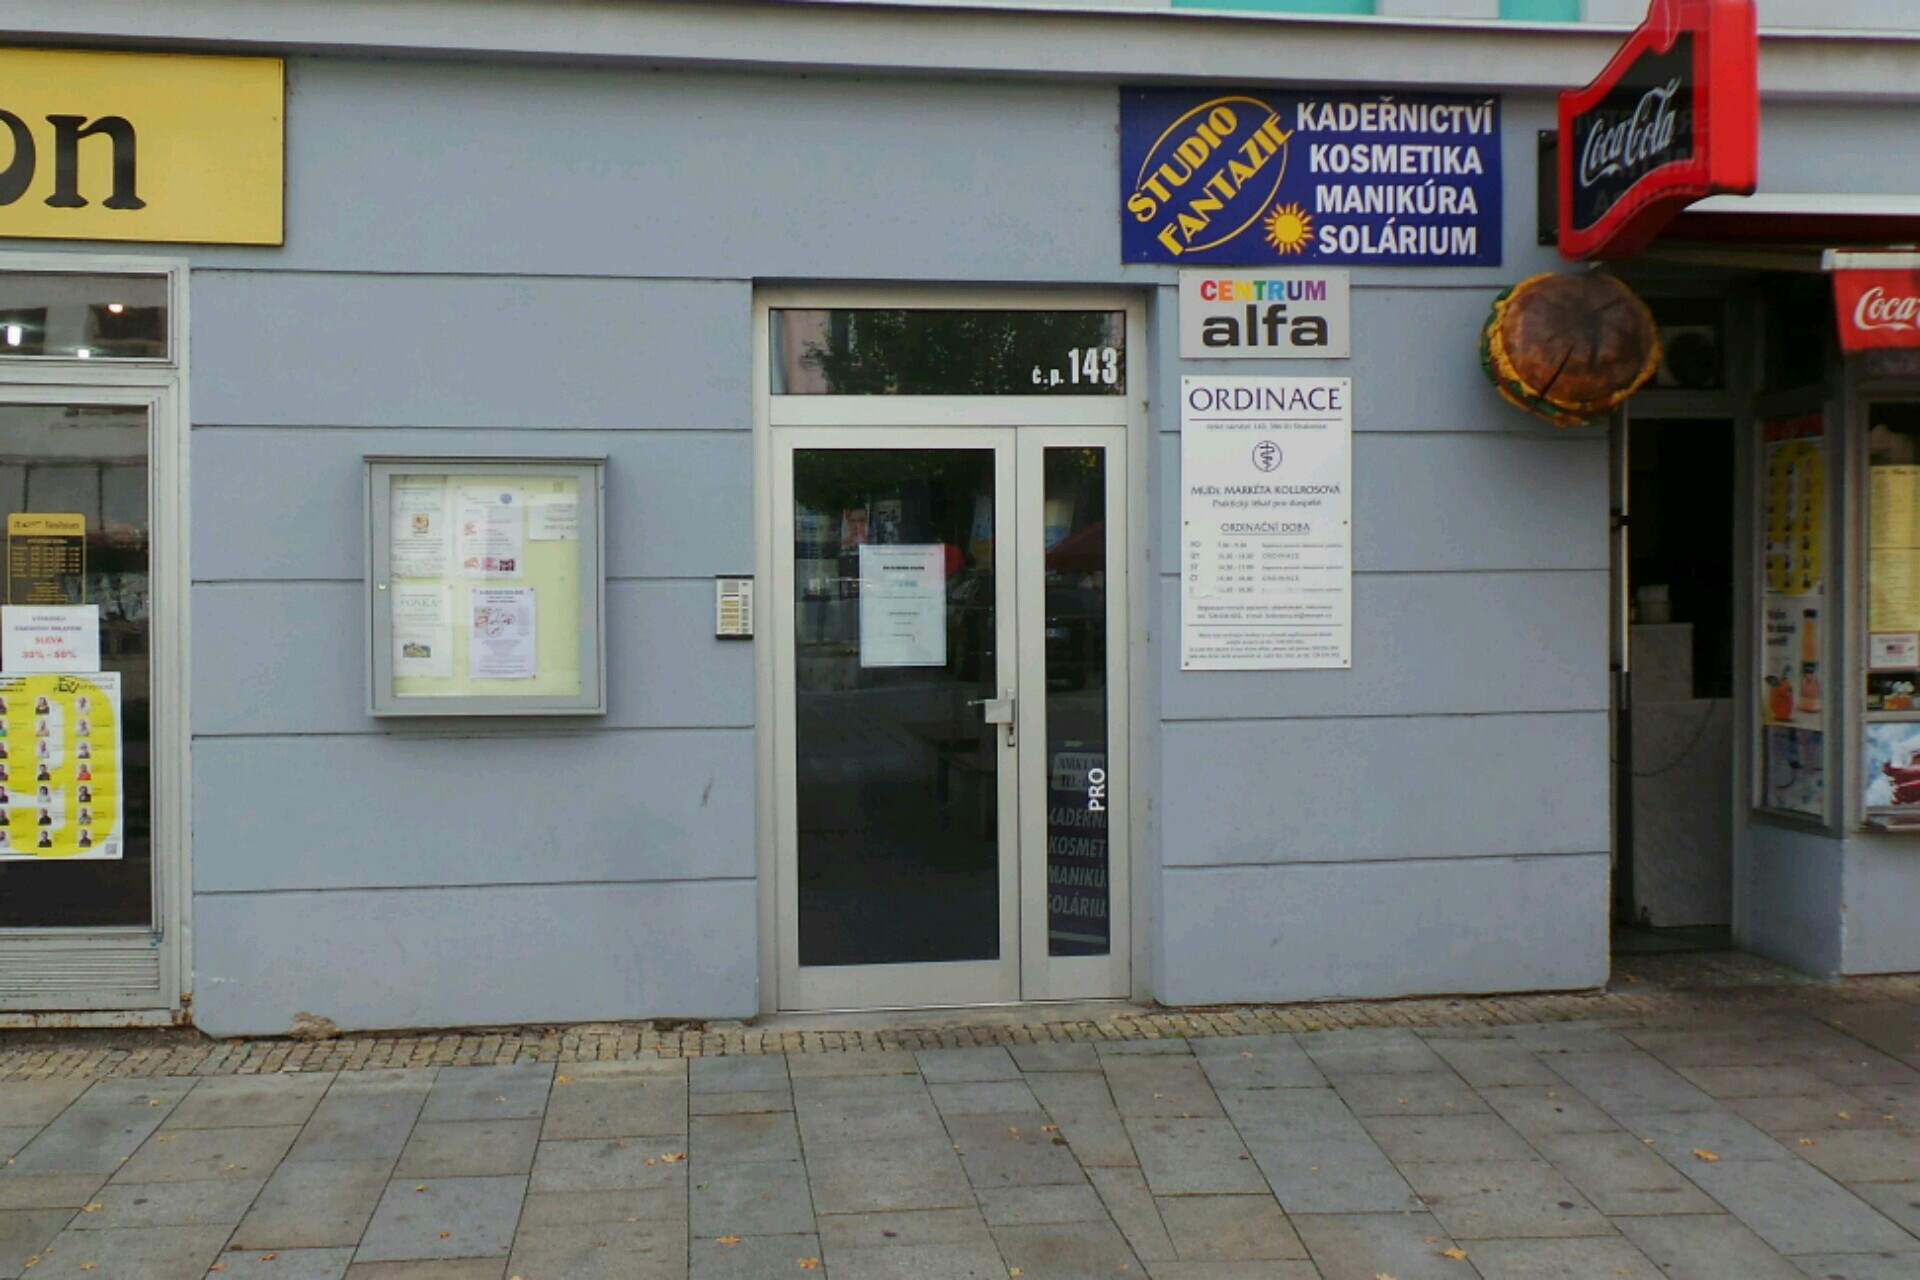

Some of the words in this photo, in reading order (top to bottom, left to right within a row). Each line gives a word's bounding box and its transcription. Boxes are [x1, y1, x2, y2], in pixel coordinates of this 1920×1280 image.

[1297, 96, 1494, 135] KADEŘNICTVÍ
[1581, 76, 1681, 187] Coca-Cola
[1127, 106, 1238, 223] STUDIO
[1309, 144, 1484, 176] KOSMETIKA
[1157, 112, 1294, 256] FANTAZIE
[1315, 179, 1479, 215] MANIKÚRA
[1318, 218, 1478, 257] SOLÁRIUM
[1200, 279, 1327, 302] CENTRUM
[1202, 304, 1328, 348] alfa
[1068, 347, 1118, 384] 143
[1189, 387, 1342, 411] ORDINACE
[1220, 521, 1279, 533] ORDINAČNÍ
[1281, 522, 1311, 533] DOBA
[1088, 768, 1106, 811] PRO
[1048, 864, 1106, 888] MANIKÚ
